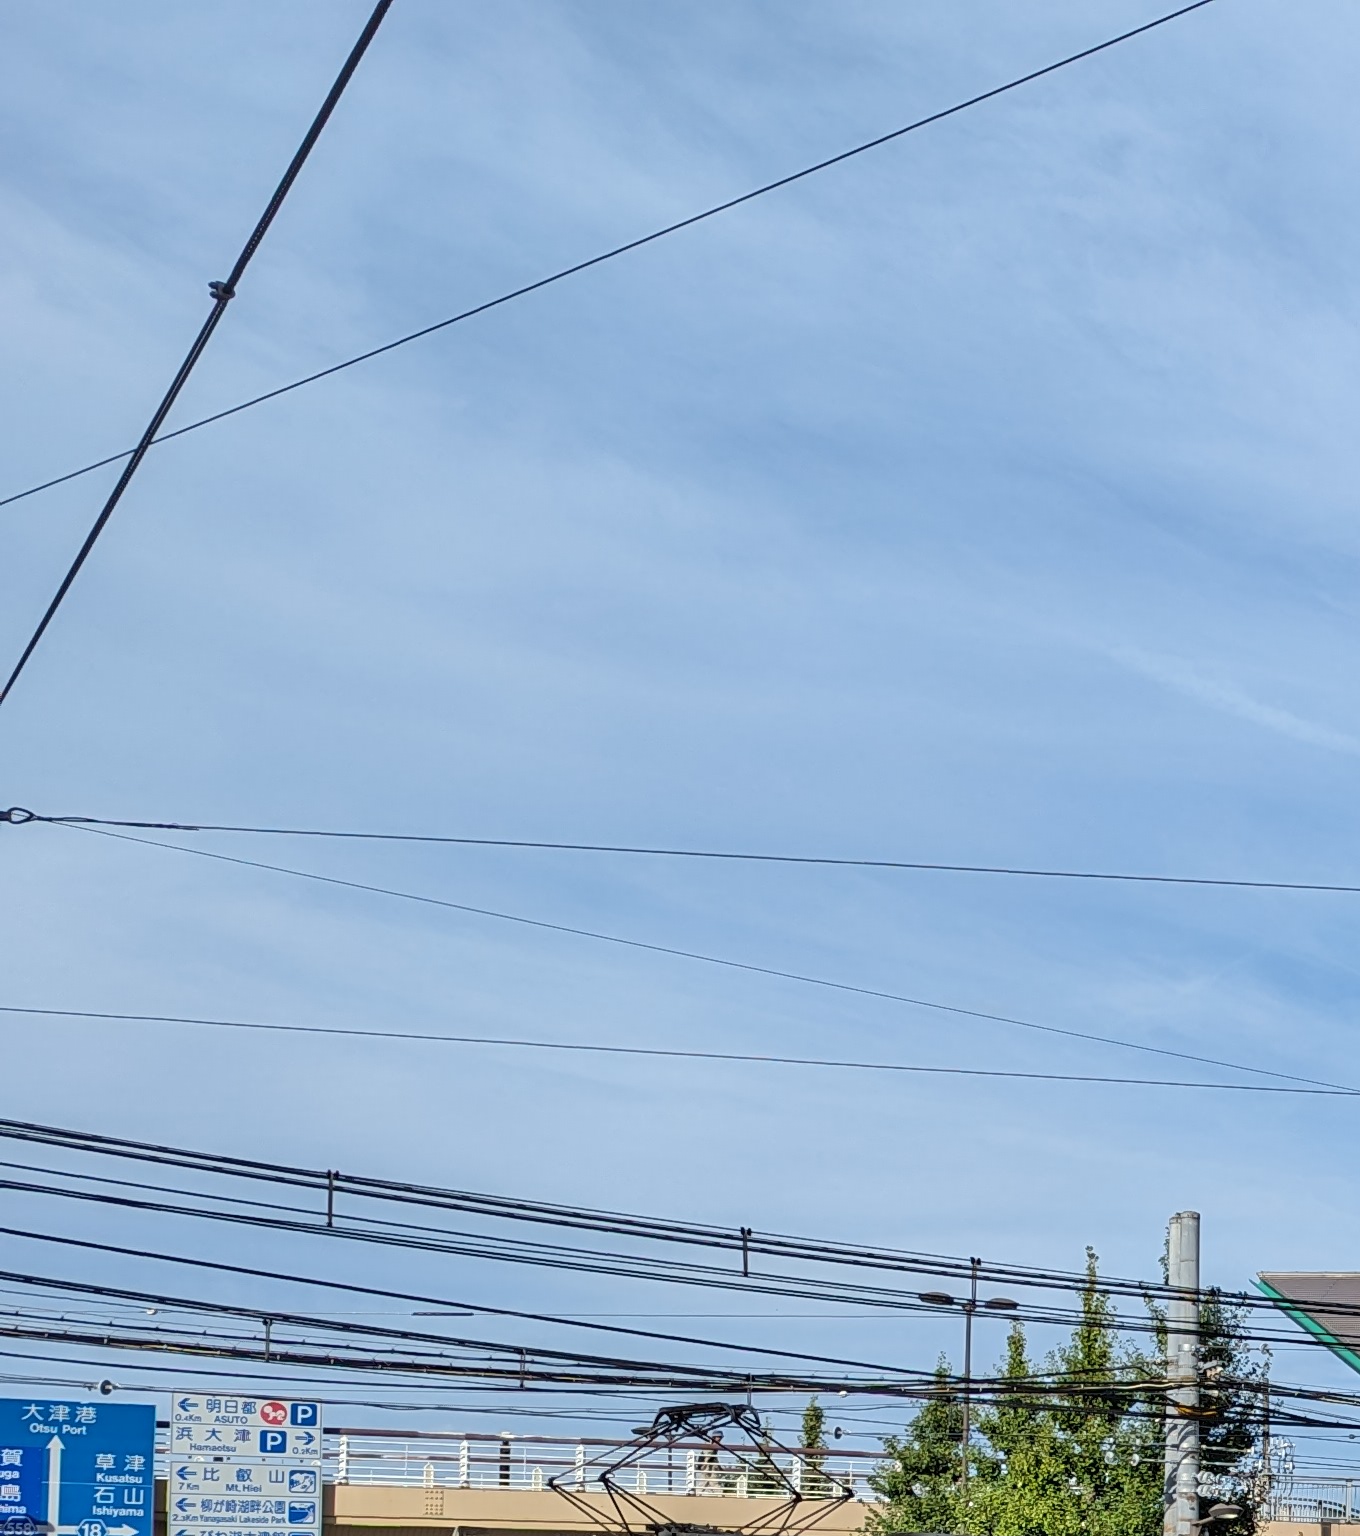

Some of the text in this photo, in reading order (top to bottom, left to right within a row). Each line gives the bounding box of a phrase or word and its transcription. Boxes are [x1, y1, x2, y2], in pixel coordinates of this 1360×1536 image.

[206, 1399, 257, 1415] 明日都
[21, 1403, 97, 1424] 大津港
[175, 1414, 202, 1422] 0.4Km
[214, 1415, 248, 1424] ASUTO
[29, 1423, 87, 1435] Otsu Port
[175, 1427, 252, 1443] 浜大津
[189, 1443, 237, 1453] Hamaotsu
[292, 1447, 319, 1455] 0.2Km
[95, 1453, 146, 1472] 草津
[96, 1473, 143, 1484] Kusatsu
[202, 1467, 285, 1484] 比叡山
[178, 1482, 200, 1491] 7 Km
[243, 1484, 262, 1493] Hiei
[93, 1487, 144, 1505] 石山
[92, 1505, 144, 1518] Ishiyama
[200, 1514, 287, 1524] Yanagasaki Lakeside Park
[6, 1522, 32, 1536] 558
